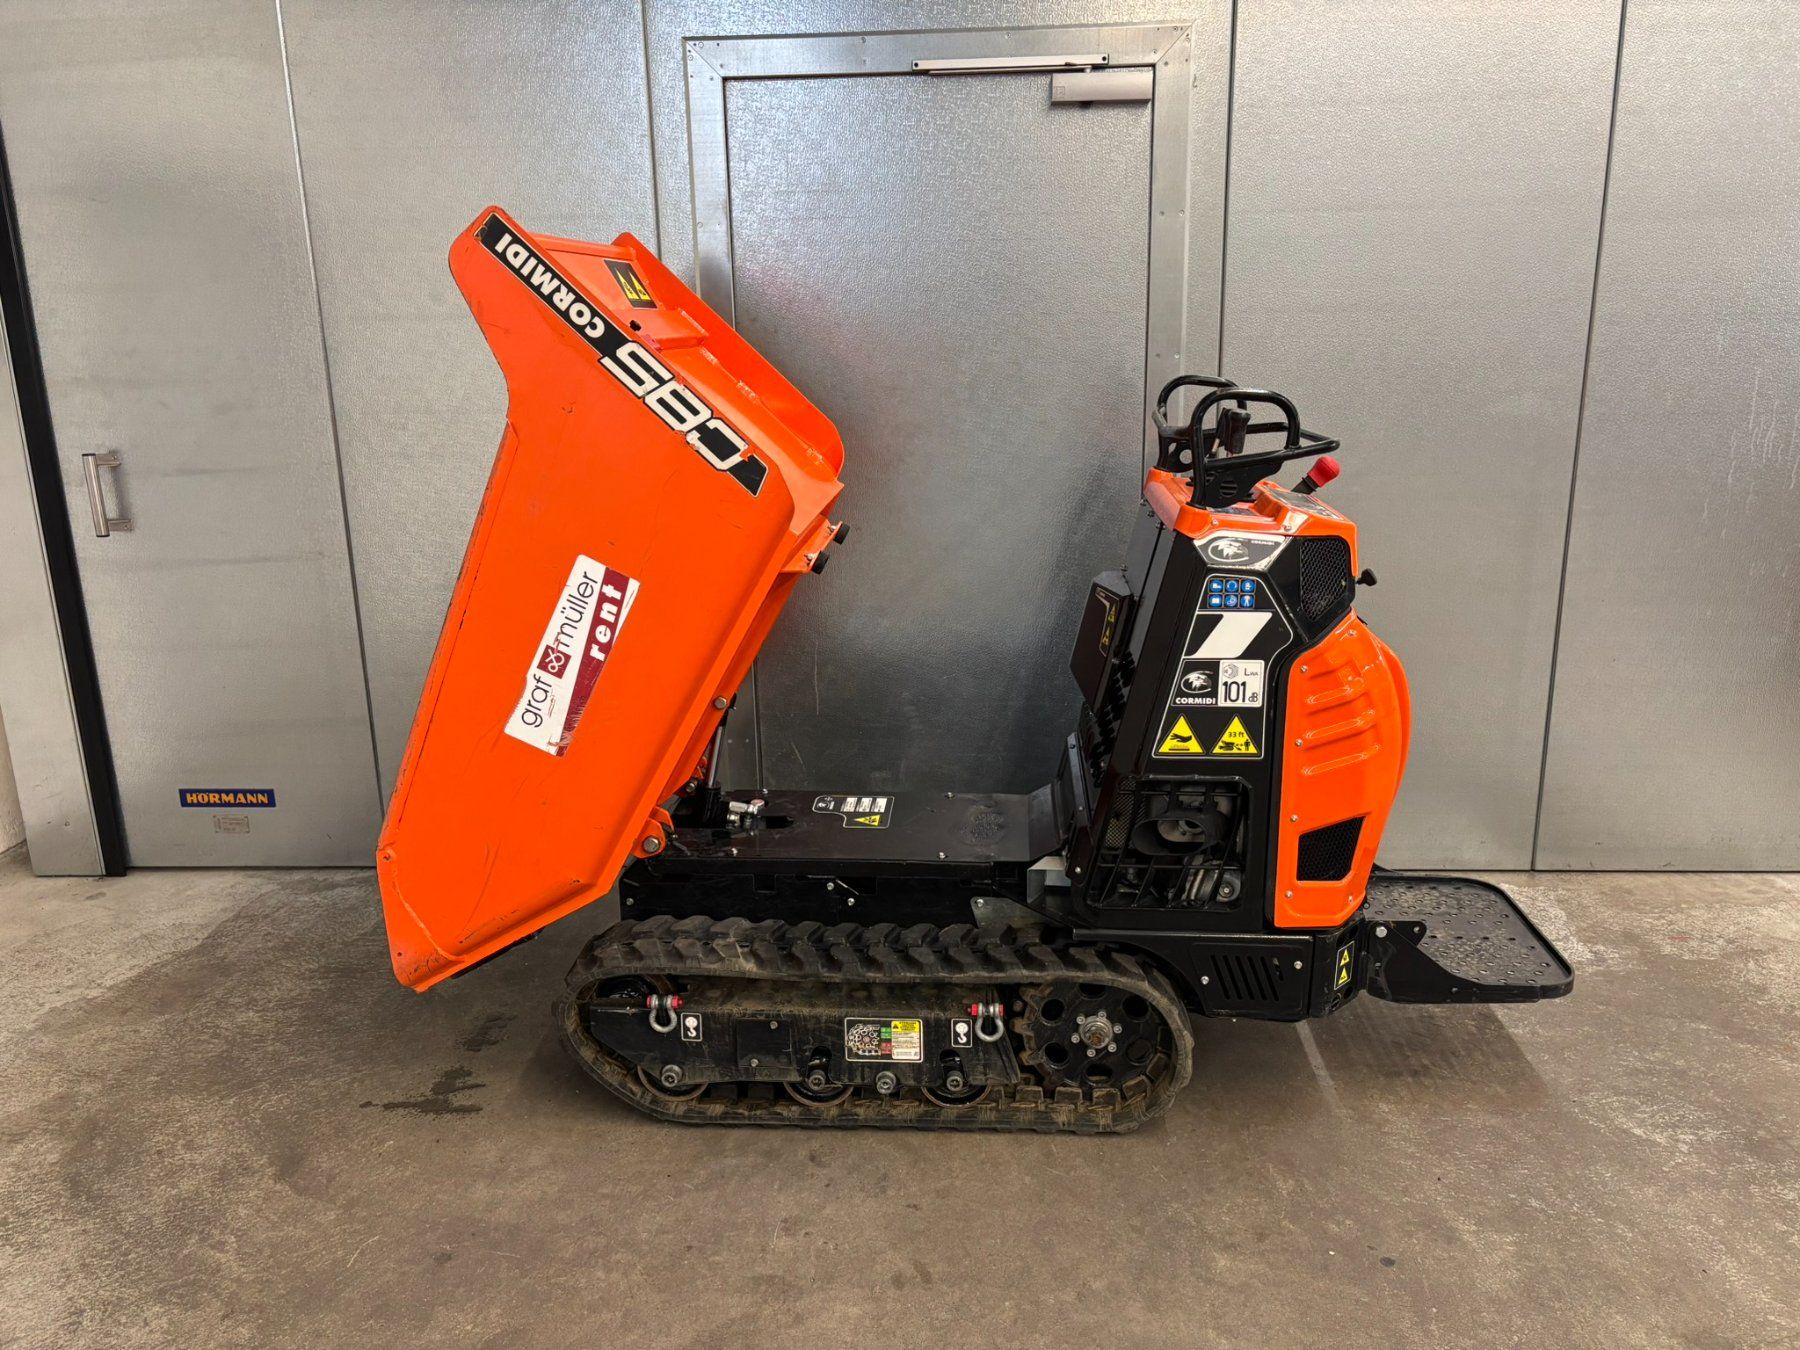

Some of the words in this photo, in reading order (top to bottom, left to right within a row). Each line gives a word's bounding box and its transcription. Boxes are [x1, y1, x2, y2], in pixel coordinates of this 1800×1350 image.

[495, 233, 605, 337] CORMIDI
[600, 341, 748, 470] C85
[521, 673, 552, 728] graf
[556, 571, 598, 649] müller
[590, 584, 622, 661] rent
[1222, 681, 1246, 702] 101
[186, 792, 269, 804] HÖRMANN
